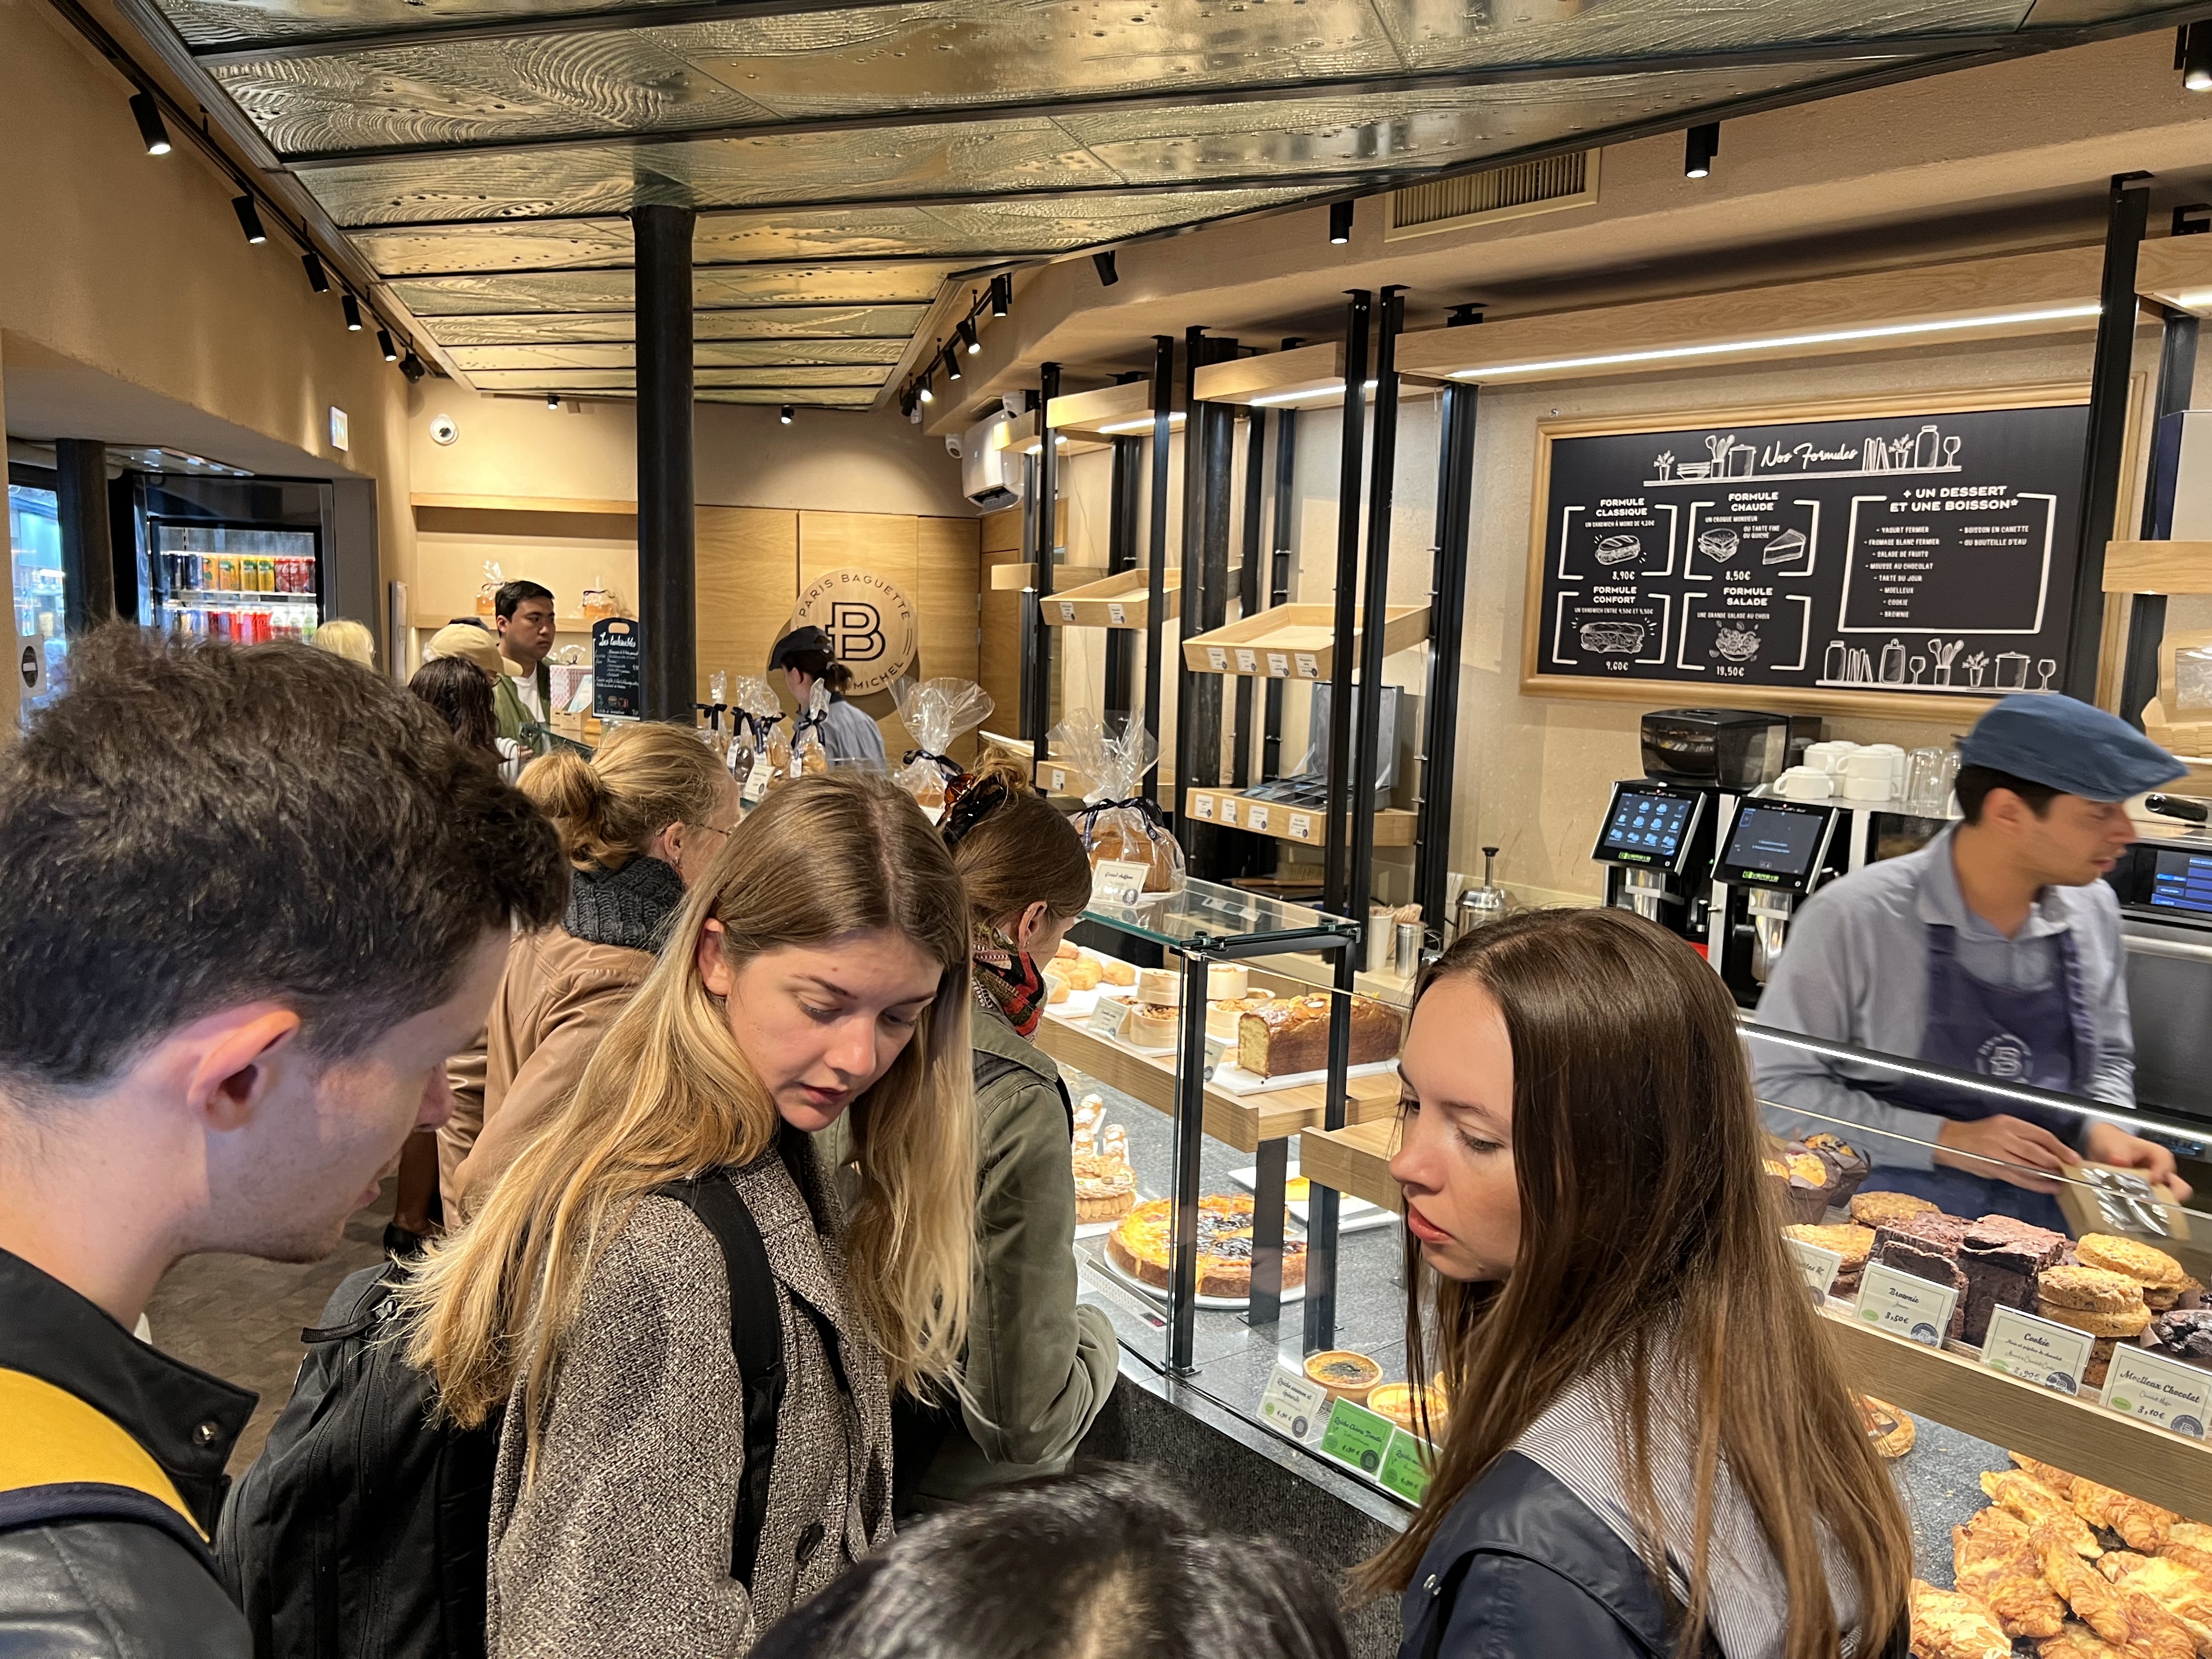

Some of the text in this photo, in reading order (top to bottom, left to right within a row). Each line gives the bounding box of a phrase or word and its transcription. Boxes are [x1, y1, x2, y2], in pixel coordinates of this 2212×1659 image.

[1760, 441, 1858, 470] Nos Formules
[1729, 492, 1779, 501] FORMULE
[1916, 488, 1936, 498] UN
[1940, 486, 2007, 497] DESSERT
[1600, 498, 1644, 506] FORMULE
[1731, 500, 1774, 511] CHAUDE
[1890, 502, 1908, 512] ET
[1911, 501, 1941, 511] UNE
[1596, 506, 1647, 516] CLASSIQUE
[798, 574, 910, 620] PARIS BAGUETTE
[1724, 587, 1773, 595] FORMULE
[1727, 597, 1767, 606] SALADE
[853, 661, 904, 690] MICHEL
[1889, 1288, 1920, 1304] Brownie
[2024, 1333, 2050, 1348] Cookie
[2120, 1370, 2200, 1403] Moelleux Chocolat
[2137, 1405, 2165, 1420] 3,10€
